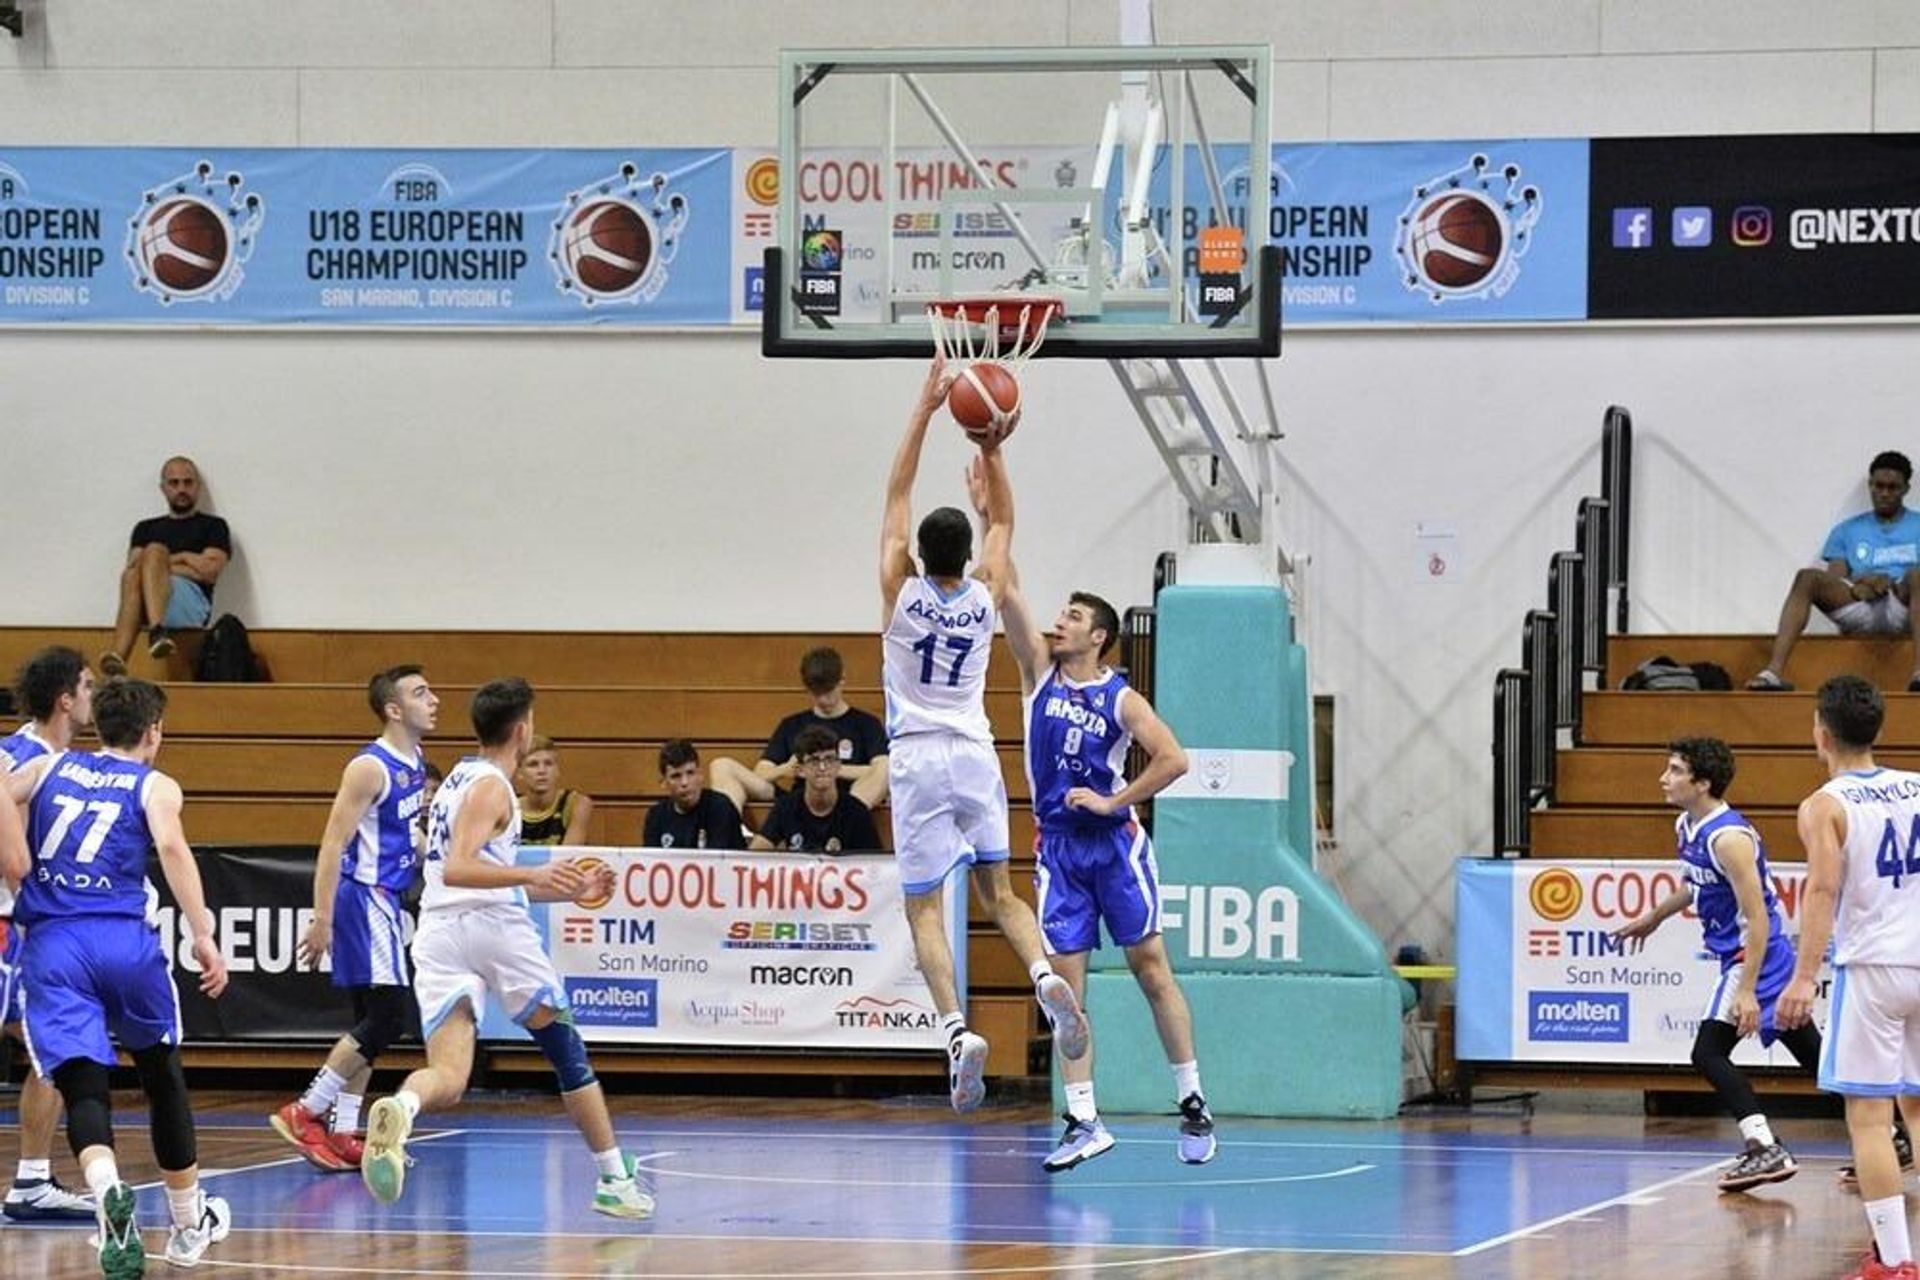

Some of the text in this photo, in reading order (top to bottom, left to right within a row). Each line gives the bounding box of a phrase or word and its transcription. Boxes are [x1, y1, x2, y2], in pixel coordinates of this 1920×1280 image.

[394, 180, 438, 202] FIBA
[1234, 176, 1279, 198] FIA
[0, 208, 100, 240] OPEAN
[310, 210, 524, 243] U18 EUROPEAN
[307, 248, 528, 280] CHAMPIONSHIP
[5, 285, 91, 305] DIVISION C
[321, 288, 354, 306] SAN
[428, 288, 496, 307] DIVISION
[500, 289, 513, 307] C
[807, 280, 836, 294] FIBA
[1205, 287, 1236, 302] FIBA
[1282, 285, 1356, 304] VISION C
[912, 632, 974, 686] 17
[38, 794, 122, 864] 77
[624, 862, 868, 912] COOL THINGS
[600, 918, 655, 945] TIM
[728, 921, 872, 942] SERISET
[1160, 884, 1301, 961] FIBA
[1566, 930, 1625, 957] TIM
[599, 953, 709, 974] San Marino
[751, 965, 853, 987] macron
[1566, 965, 1684, 987] San Marino
[572, 986, 649, 1008] molten
[835, 1011, 937, 1029] TITANKA!
[1537, 1000, 1621, 1022] molten
